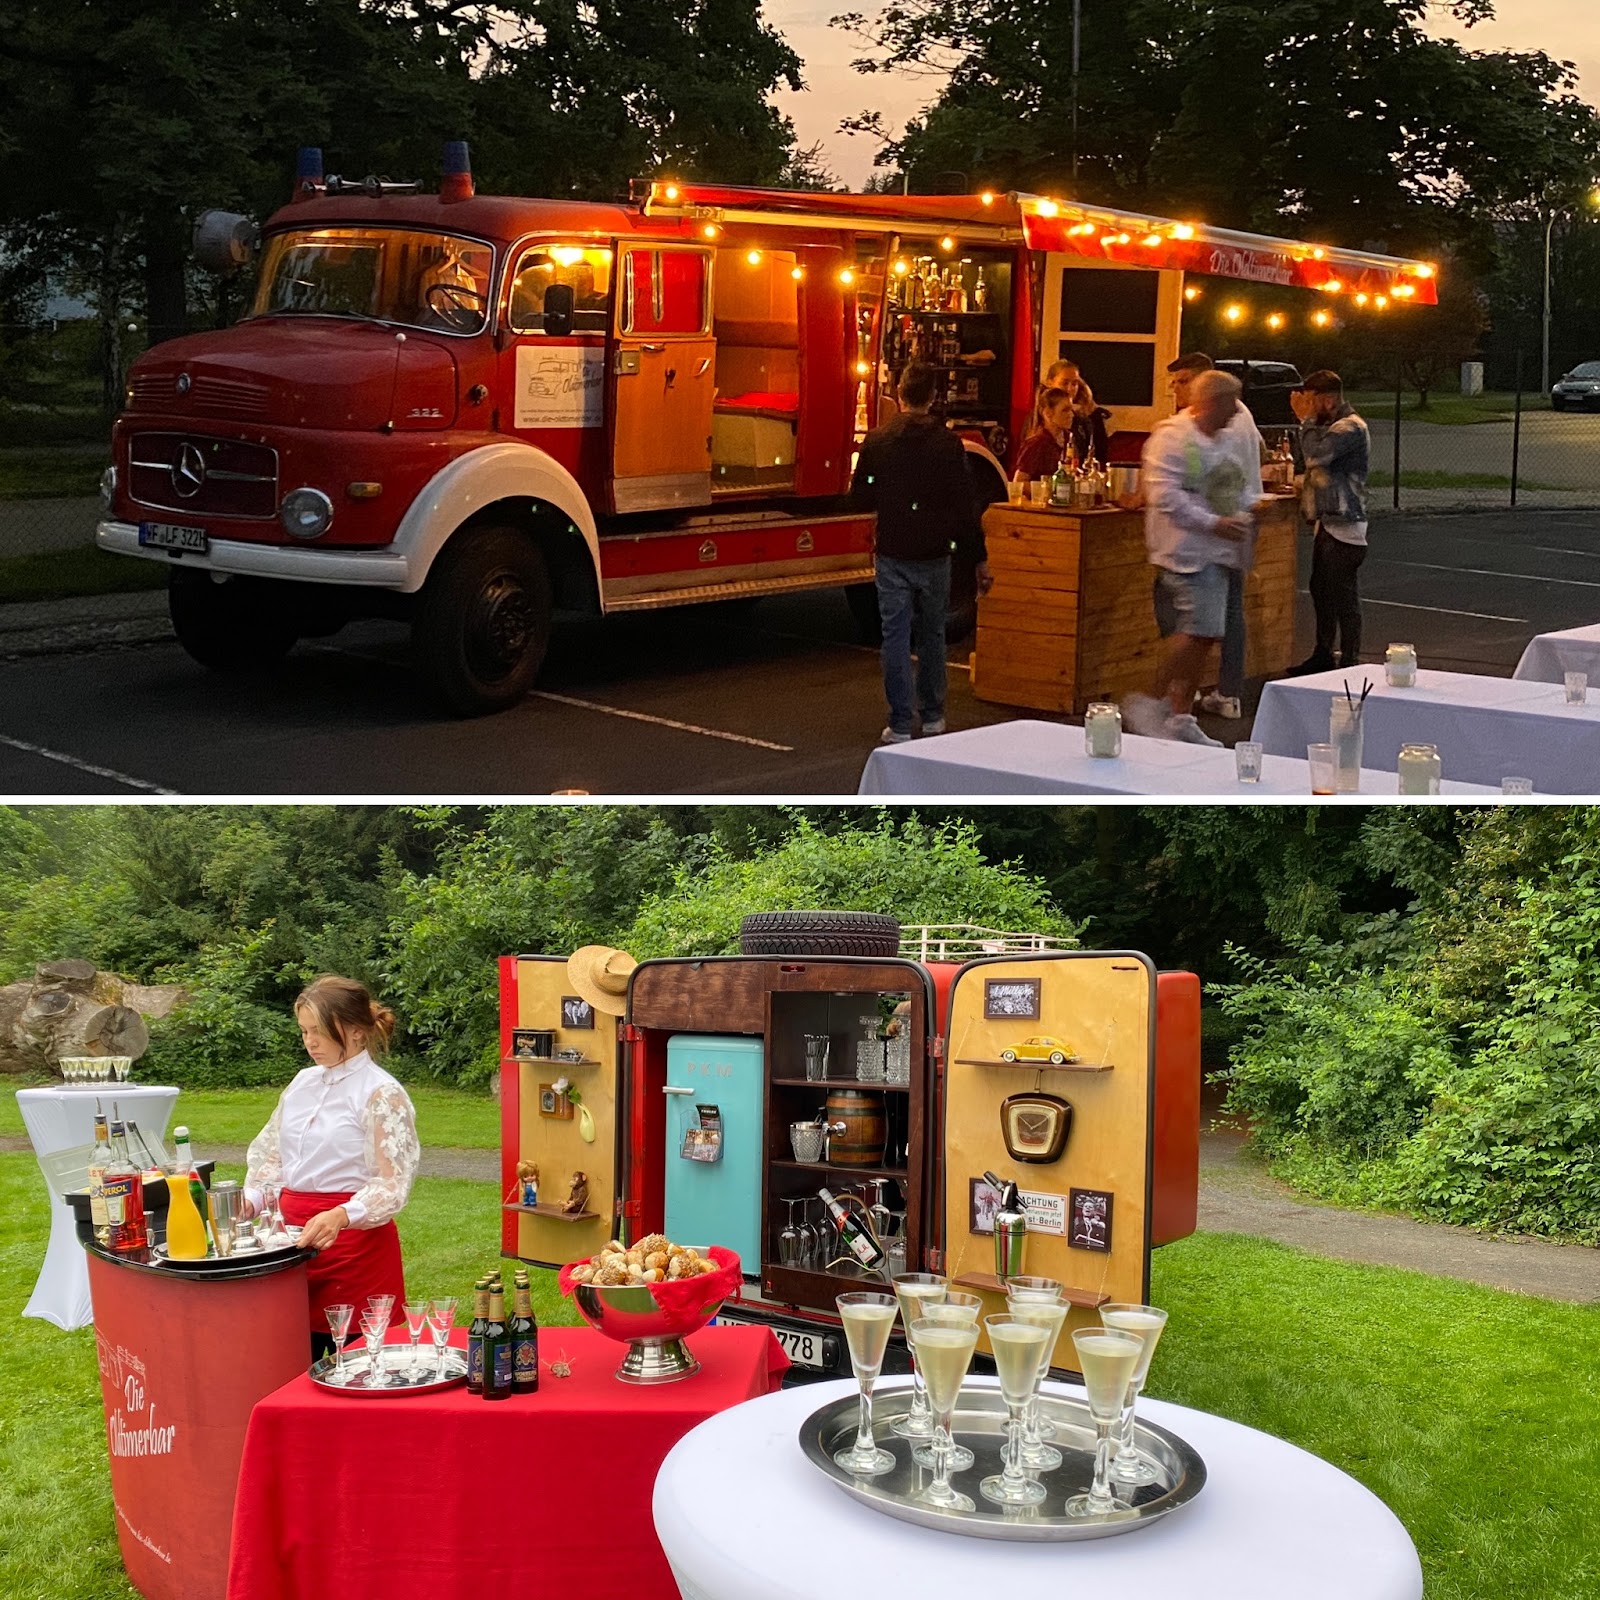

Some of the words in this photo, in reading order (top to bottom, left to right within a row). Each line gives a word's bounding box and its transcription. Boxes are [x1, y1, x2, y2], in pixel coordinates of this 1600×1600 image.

[1209, 249, 1230, 275] Die
[411, 408, 440, 417] 322
[1020, 1196, 1058, 1209] ACHTUNG
[1028, 1216, 1062, 1227] st-Berlin
[124, 1374, 145, 1413] Die
[109, 1402, 175, 1457] Oldtimerbar
